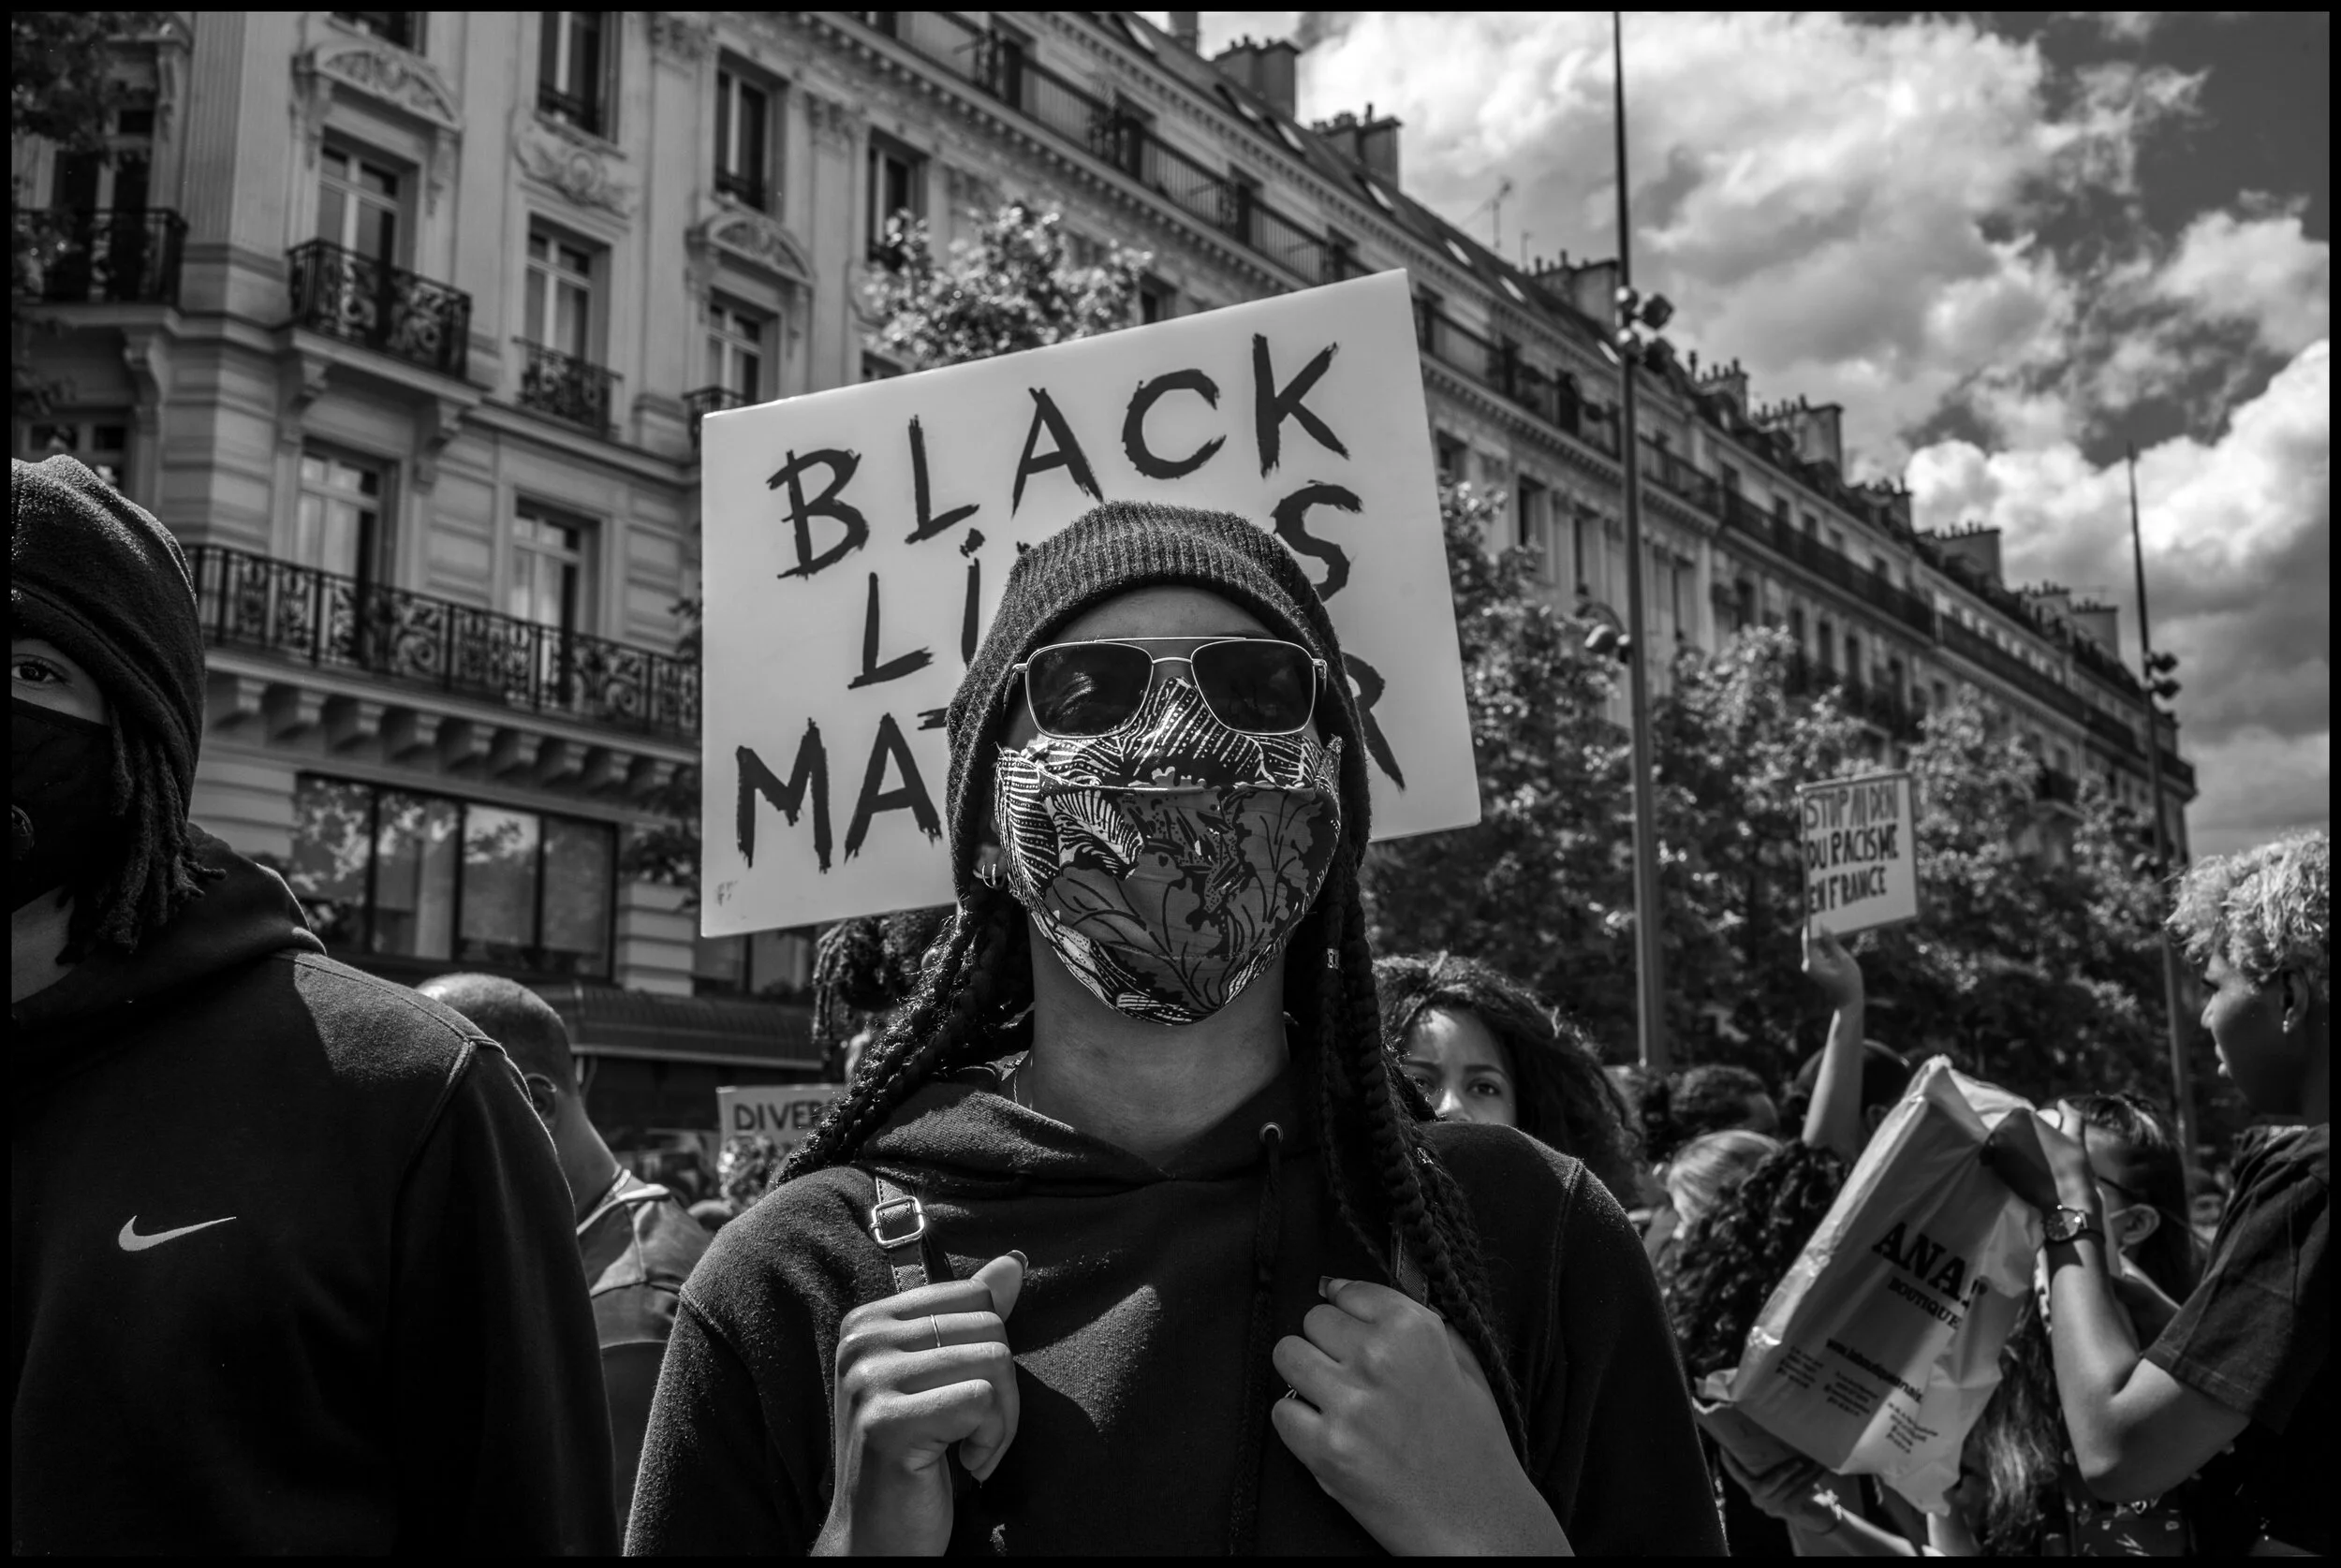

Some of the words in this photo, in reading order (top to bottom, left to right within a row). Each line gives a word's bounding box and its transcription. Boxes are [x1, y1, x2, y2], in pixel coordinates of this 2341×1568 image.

[766, 332, 1350, 579] BLACK
[736, 655, 1406, 873] MAR
[1807, 838, 1827, 870] DU
[1831, 823, 1899, 866] RACISME
[1809, 878, 1826, 914] EN
[1829, 866, 1887, 910] FRANCE
[734, 1100, 831, 1132] DIVER
[1888, 1276, 1963, 1330] BOUTIQUE
